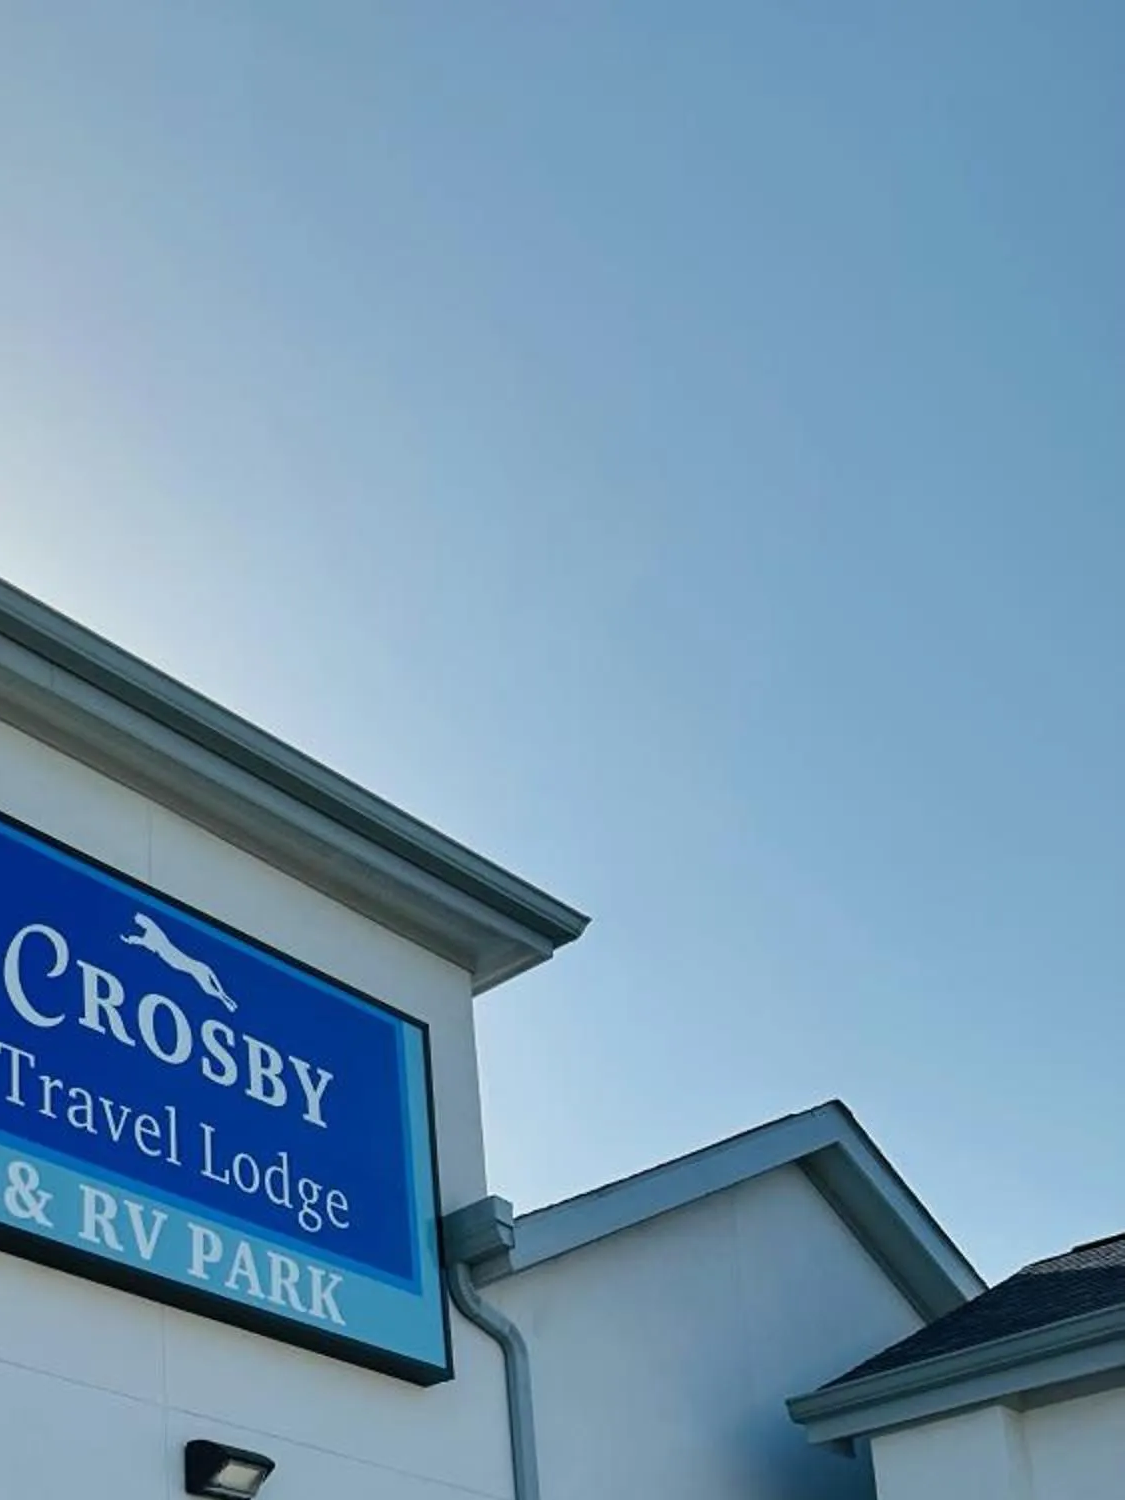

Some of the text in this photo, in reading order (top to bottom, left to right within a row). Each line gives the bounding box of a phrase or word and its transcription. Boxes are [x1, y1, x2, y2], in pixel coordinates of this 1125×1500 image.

[3, 923, 335, 1129] CROSBY
[3, 1160, 347, 1326] & RV PARK
[200, 1123, 350, 1233] Lodge
